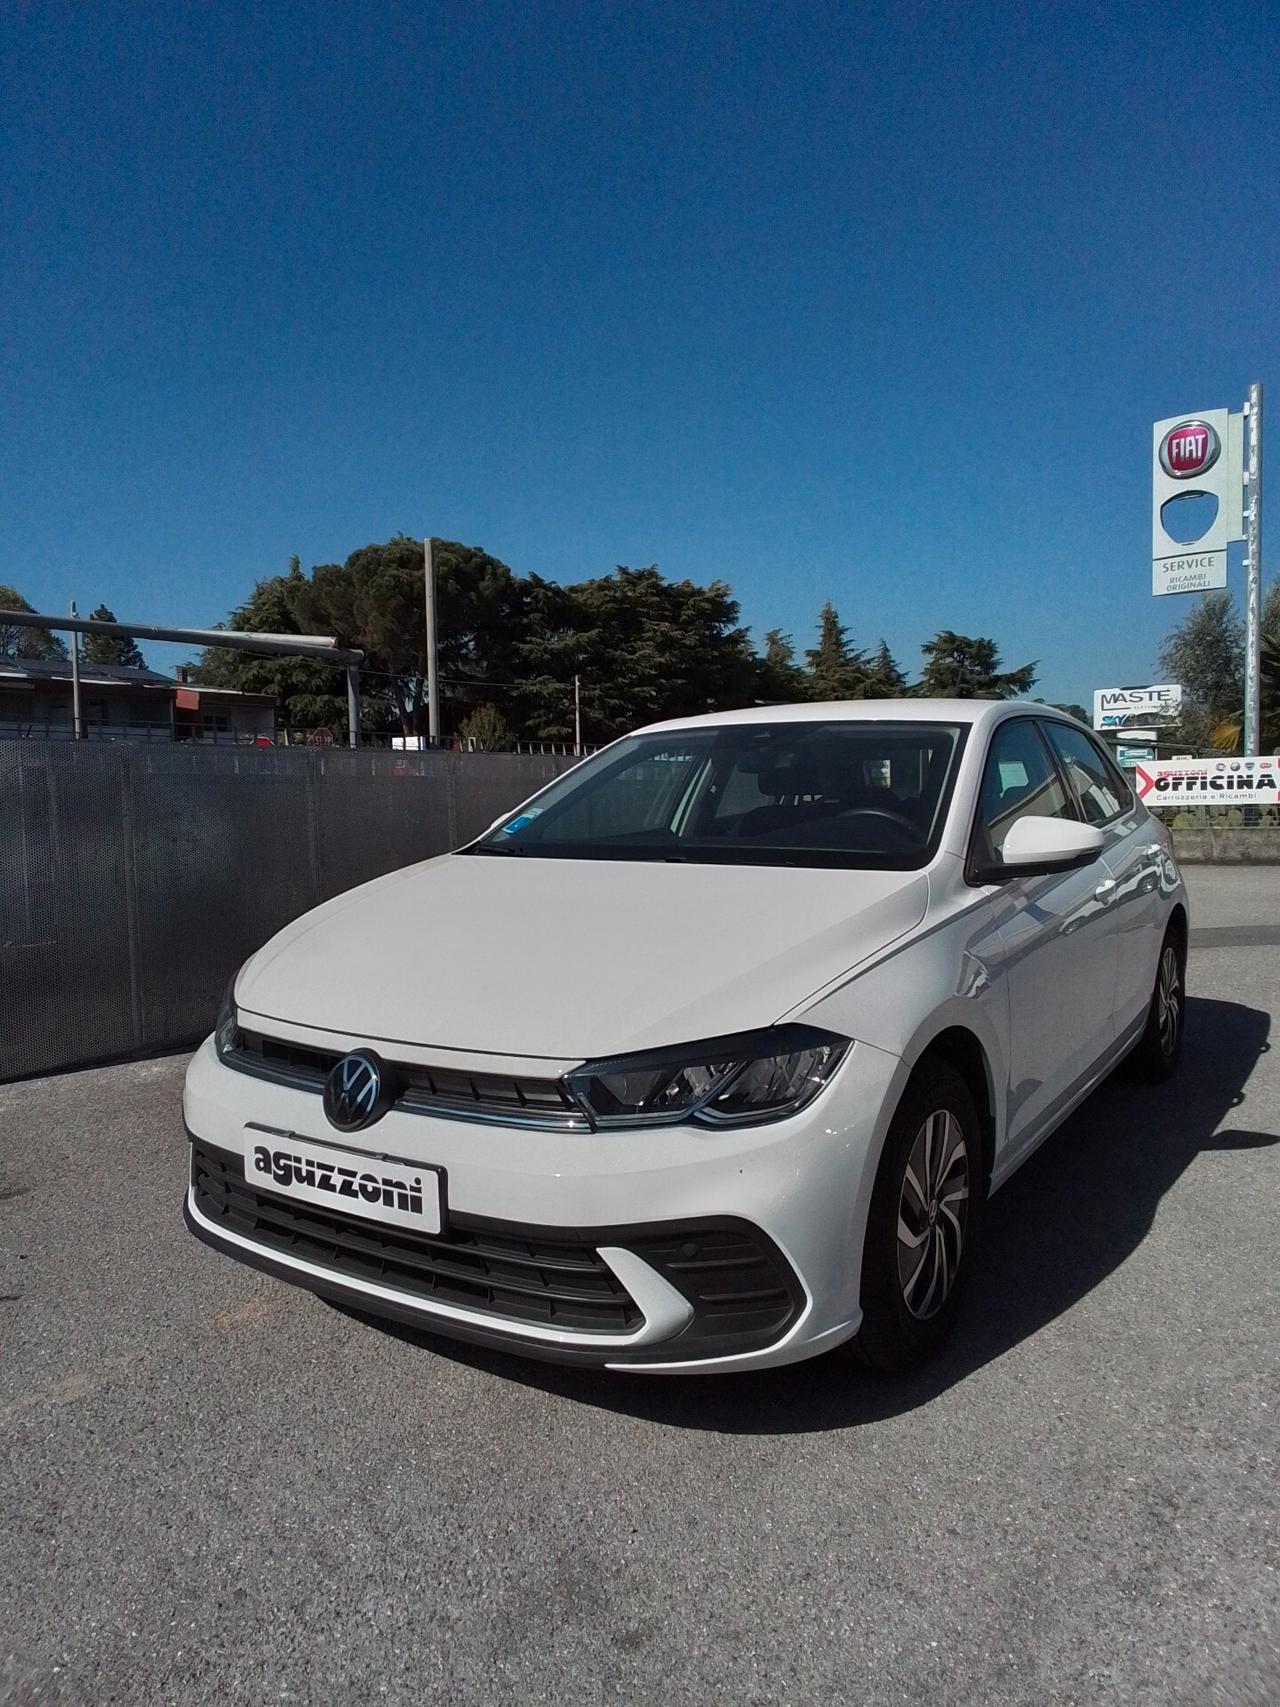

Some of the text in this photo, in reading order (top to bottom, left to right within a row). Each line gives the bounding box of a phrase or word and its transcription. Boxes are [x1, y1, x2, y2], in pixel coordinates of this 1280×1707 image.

[1171, 434, 1206, 463] FIAT
[1162, 556, 1215, 573] SERVICE
[1166, 580, 1211, 592] ORIGINALI
[1169, 573, 1207, 584] RICAMBI
[254, 1146, 423, 1215] aguzzoni
